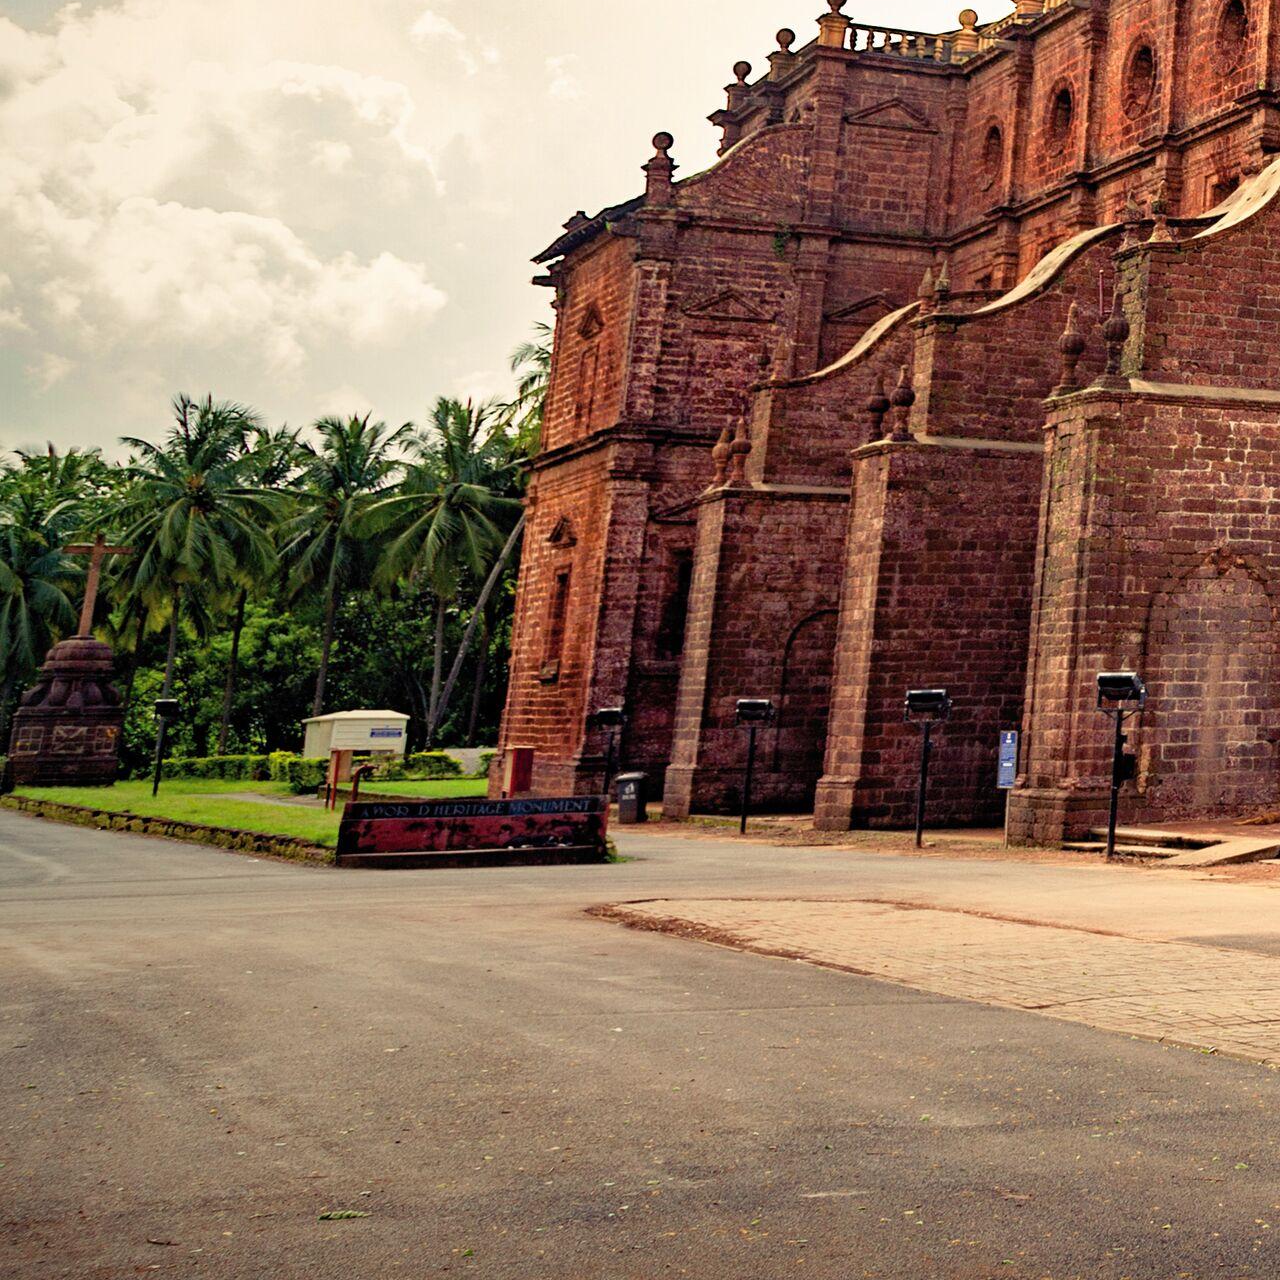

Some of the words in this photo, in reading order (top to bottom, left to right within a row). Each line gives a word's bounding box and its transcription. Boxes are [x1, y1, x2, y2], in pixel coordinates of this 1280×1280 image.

[361, 806, 370, 817] A
[373, 805, 431, 817] WORD
[434, 802, 505, 816] HERITAGE
[510, 799, 592, 814] MONUMENT
